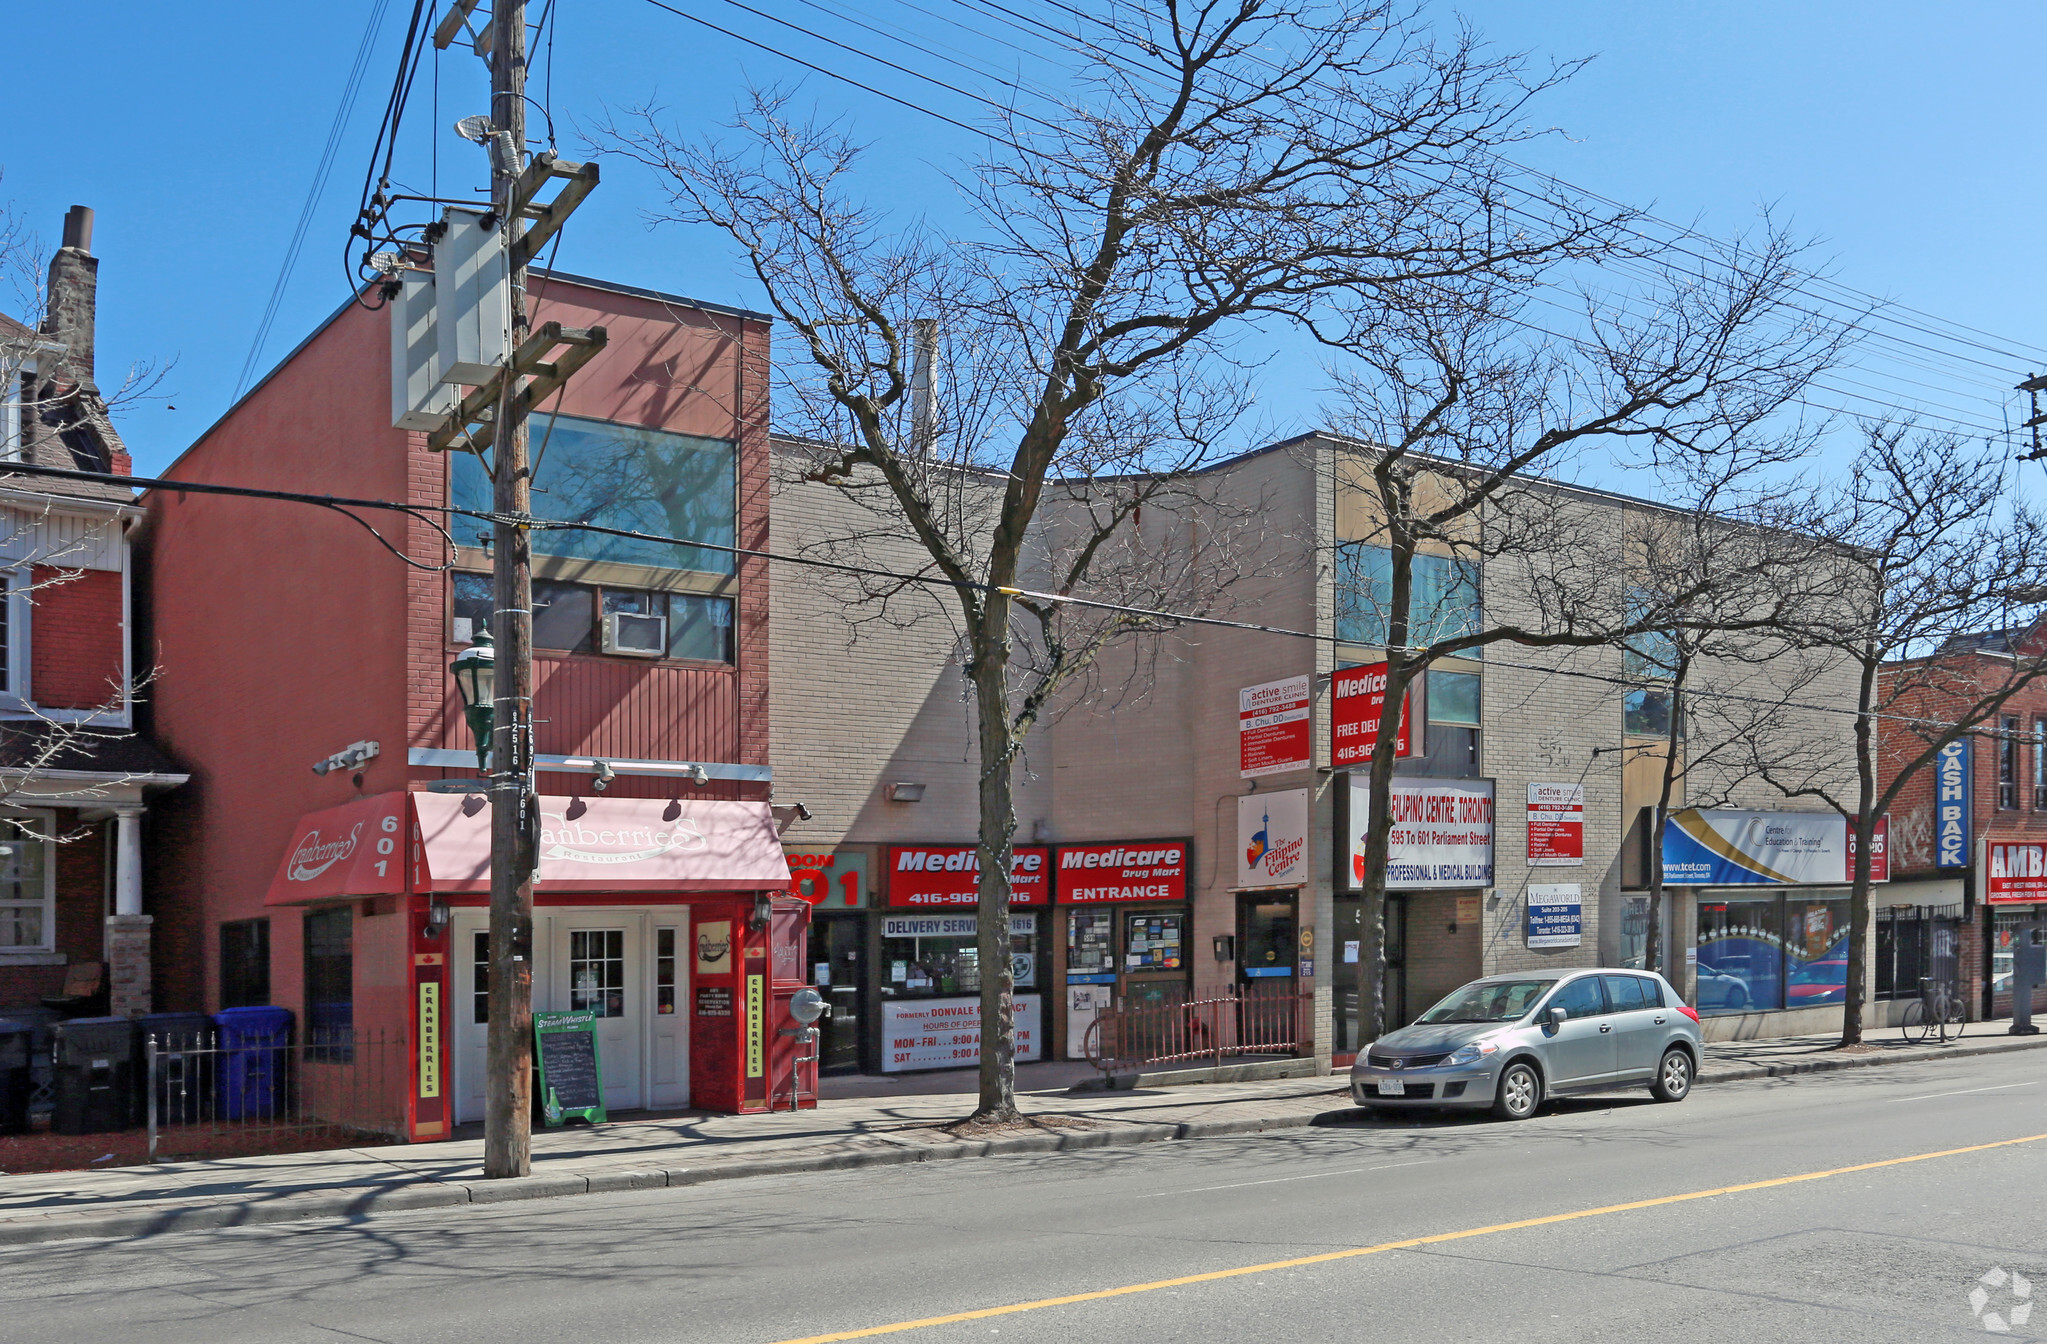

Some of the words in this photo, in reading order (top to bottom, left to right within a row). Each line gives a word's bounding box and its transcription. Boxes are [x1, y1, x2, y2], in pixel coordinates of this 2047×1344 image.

[1252, 687, 1280, 701] active
[1282, 681, 1307, 695] smile
[1336, 673, 1387, 699] Medica
[1252, 696, 1282, 707] DENTURE
[1283, 691, 1307, 700] CLINIC
[1371, 696, 1385, 705] Dru
[1246, 720, 1254, 729] B.
[1273, 713, 1284, 724] DD
[1252, 709, 1268, 718] (416)
[1257, 725, 1279, 734] Dentures
[1337, 722, 1359, 738] FREE
[1361, 713, 1405, 734] DELIY
[1263, 730, 1286, 738] Dentures
[1273, 734, 1296, 742] Dentures
[1337, 738, 1405, 759] 416-966
[1941, 740, 1963, 801] CASH
[1537, 786, 1561, 796] active
[1391, 794, 1424, 823] FILIPINO
[1458, 796, 1492, 824] TORONTO
[1391, 830, 1405, 845] 595
[1406, 830, 1416, 845] To
[1417, 830, 1430, 845] 601
[1431, 830, 1468, 845] Parliament
[1469, 831, 1491, 845] Street
[1765, 825, 1785, 835] Centre
[1940, 805, 1963, 866] BACK
[374, 815, 399, 877] 601
[1765, 838, 1794, 846] Education
[563, 850, 643, 863] Restaurant
[1061, 848, 1181, 870] Medicare
[1264, 836, 1303, 867] Filipino
[786, 854, 834, 867] OOM
[897, 851, 1041, 871] Medire
[1268, 851, 1300, 877] Centre
[1662, 862, 1711, 872] www.tcet.com
[1010, 874, 1040, 884] Mart
[1122, 869, 1149, 879] Drug
[1152, 868, 1181, 877] Mart
[1386, 864, 1432, 881] PROFESSIONAL
[1433, 864, 1438, 880] &
[1439, 864, 1464, 880] MEDICAL
[1465, 864, 1492, 880] BUILDING
[1072, 885, 1169, 900] ENTRANCE
[1530, 892, 1580, 904] MEGAWORLD
[888, 920, 941, 934] DELIVERY
[943, 919, 977, 933] SERVI
[1009, 919, 1032, 930] -1616
[931, 1006, 974, 1018] DONVALE
[923, 1021, 949, 1030] HOURS
[950, 1020, 962, 1029] OF
[1017, 1031, 1030, 1041] PM
[894, 1053, 911, 1063] SAT
[1016, 1044, 1030, 1054] PM
